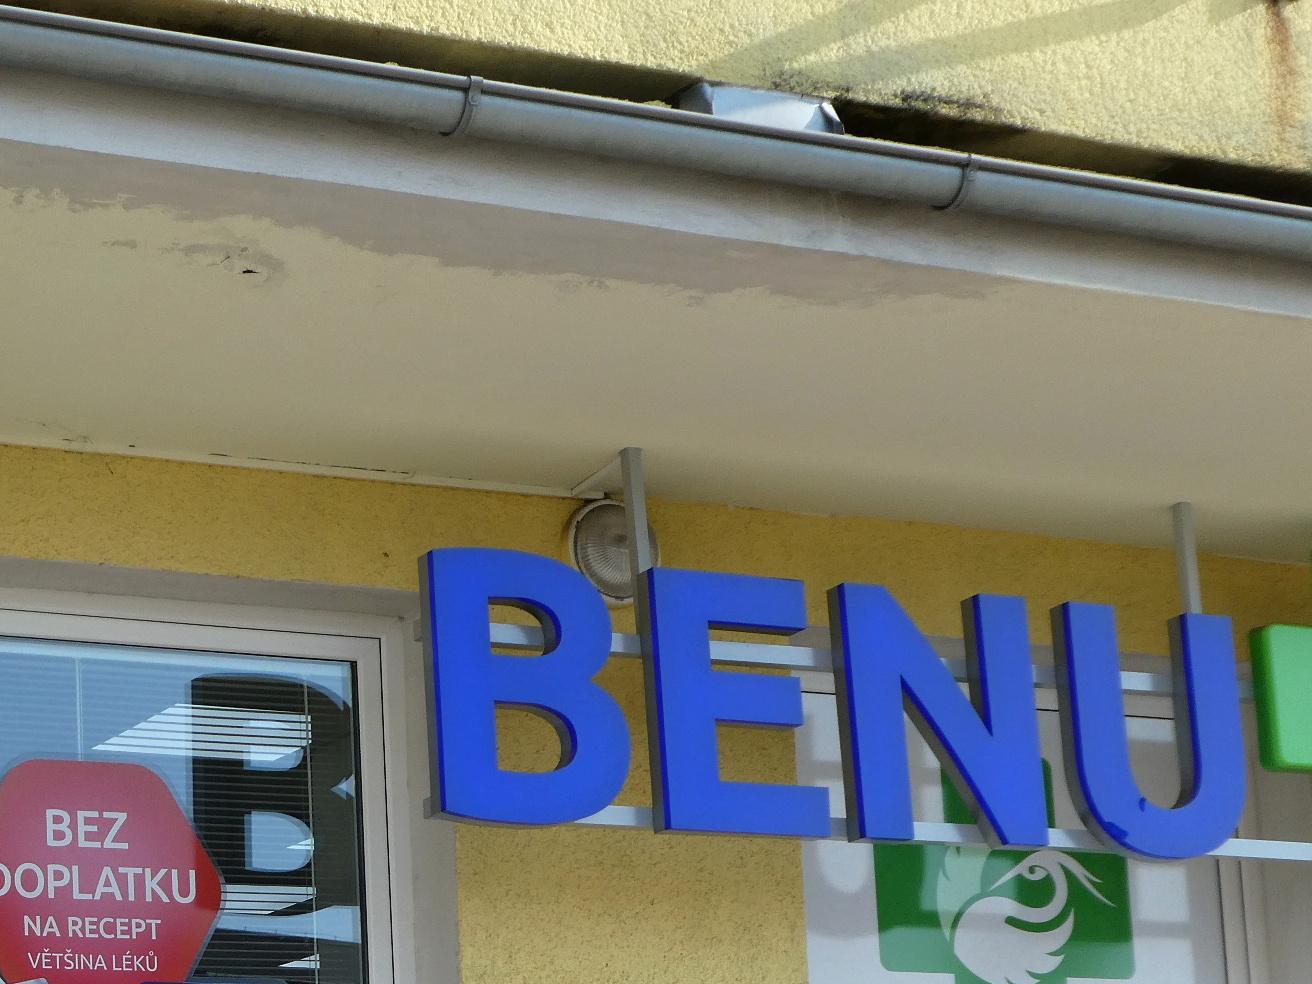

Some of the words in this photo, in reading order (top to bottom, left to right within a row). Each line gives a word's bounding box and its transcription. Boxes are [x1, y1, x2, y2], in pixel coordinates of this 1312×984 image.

[418, 546, 1250, 860] BENU
[45, 808, 128, 850] BEZ
[24, 915, 60, 936] NA
[68, 916, 160, 939] RECEPT
[28, 948, 106, 970] VĚTŠINA
[112, 950, 157, 971] LÉKŮ
